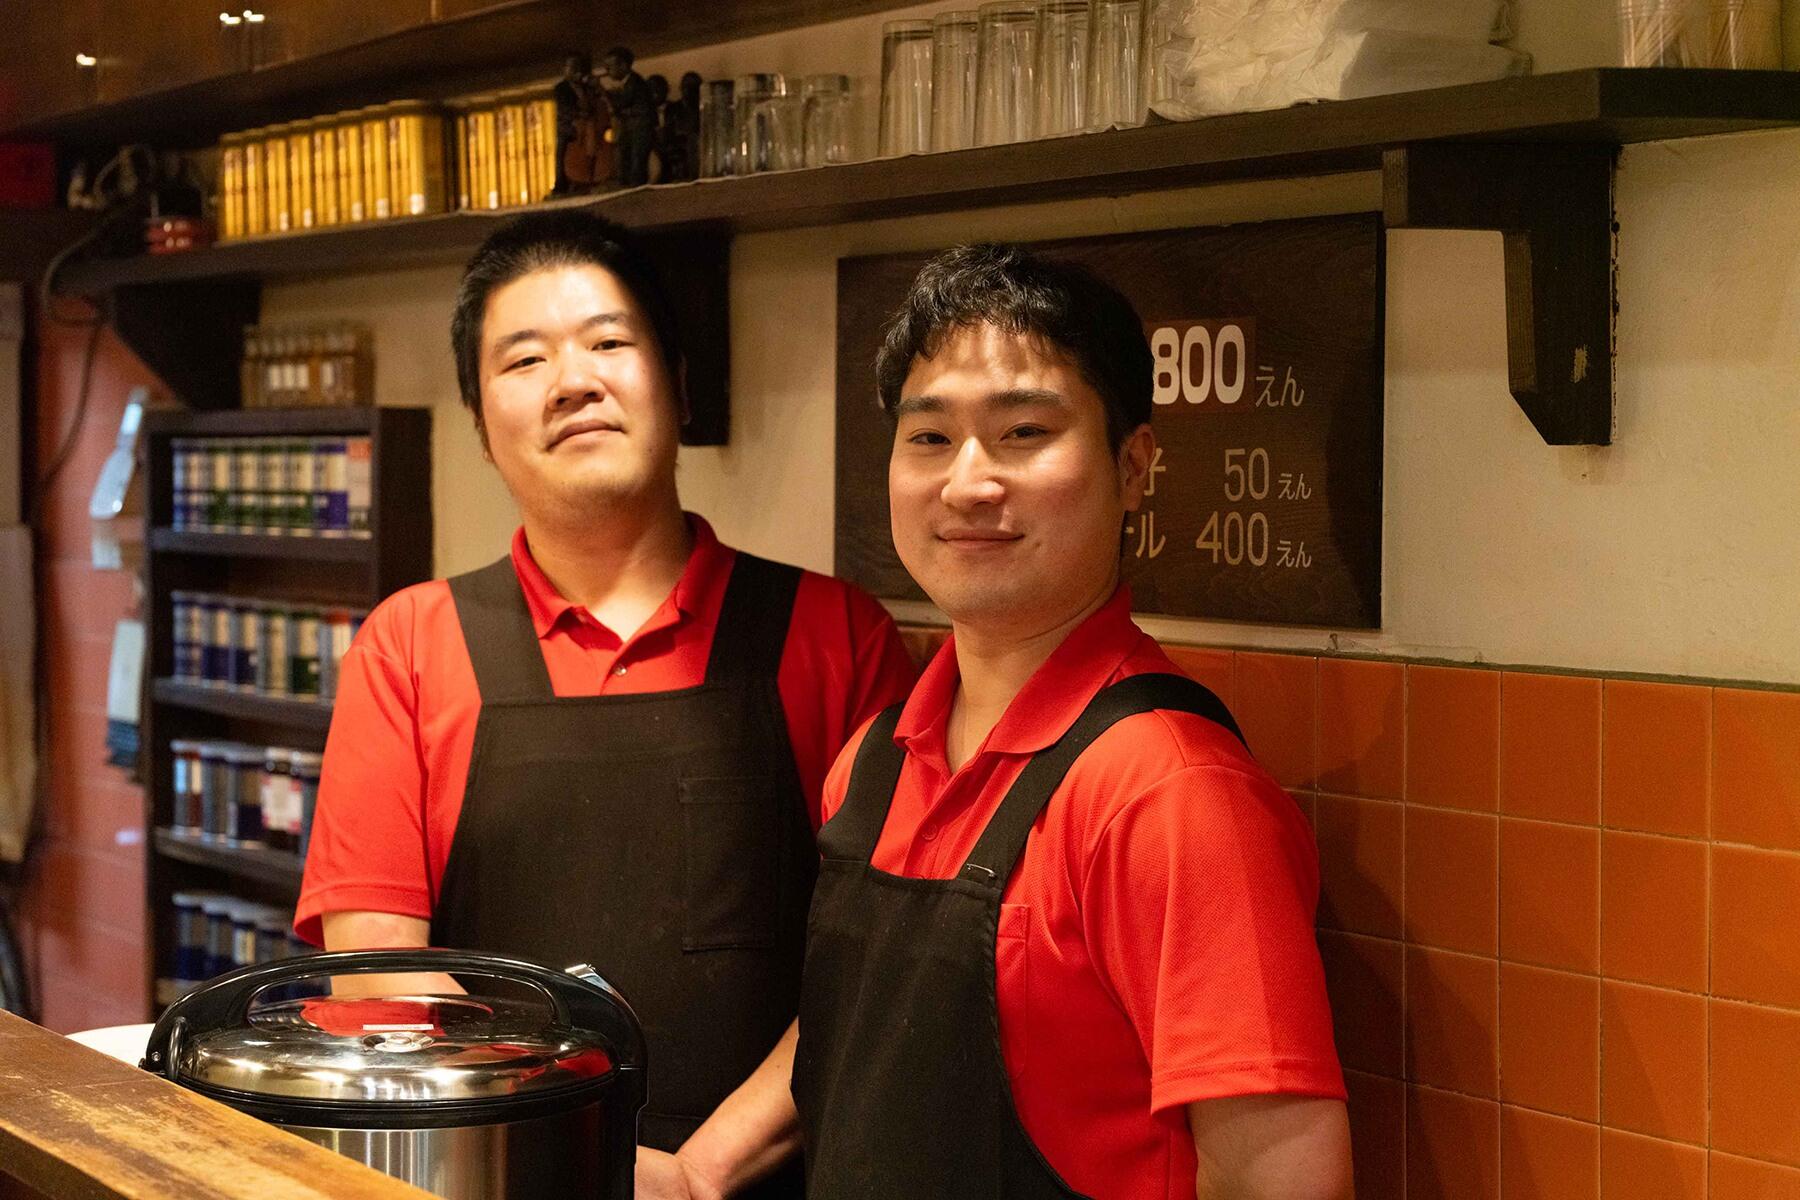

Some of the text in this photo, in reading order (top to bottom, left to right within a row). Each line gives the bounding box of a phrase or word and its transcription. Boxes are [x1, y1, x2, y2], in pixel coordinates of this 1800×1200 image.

[1151, 324, 1305, 408] 800 えん
[1224, 447, 1270, 502] 50
[1277, 472, 1312, 500] えん
[1195, 510, 1269, 566] 400
[1276, 539, 1312, 568] えん
